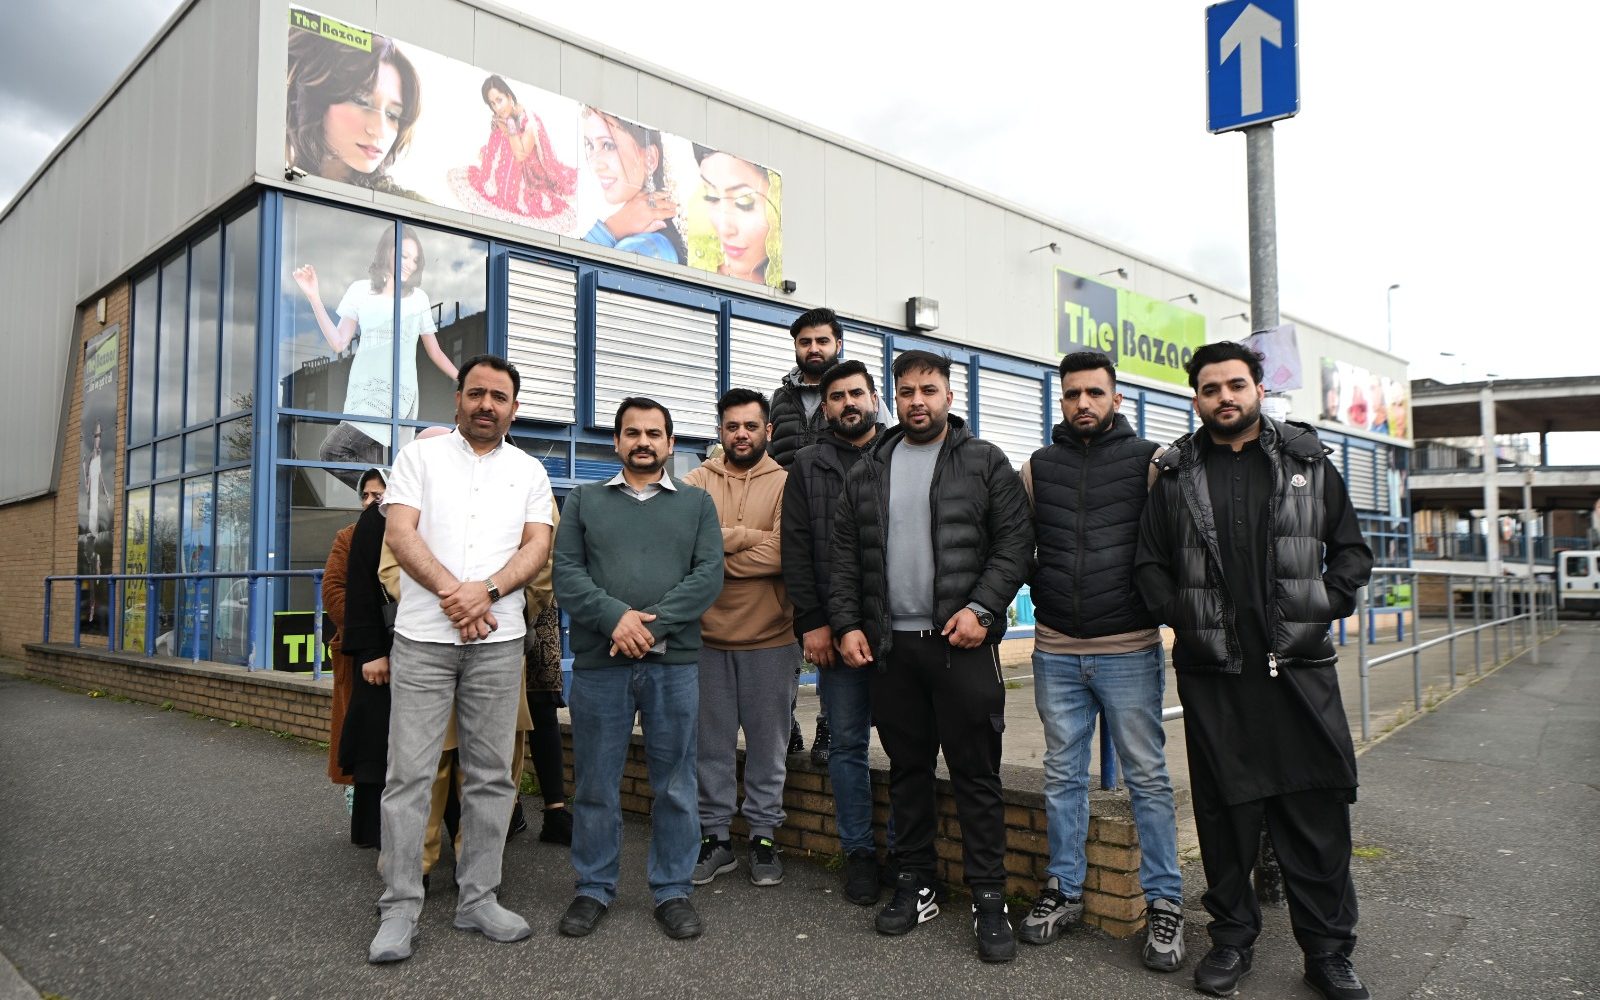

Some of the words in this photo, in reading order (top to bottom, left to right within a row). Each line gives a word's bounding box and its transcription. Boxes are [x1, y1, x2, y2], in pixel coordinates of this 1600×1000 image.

[294, 13, 319, 30] The
[323, 23, 367, 46] Bazaar
[1064, 301, 1114, 352] The
[1122, 319, 1192, 374] Bazaa
[282, 634, 332, 664] Th
